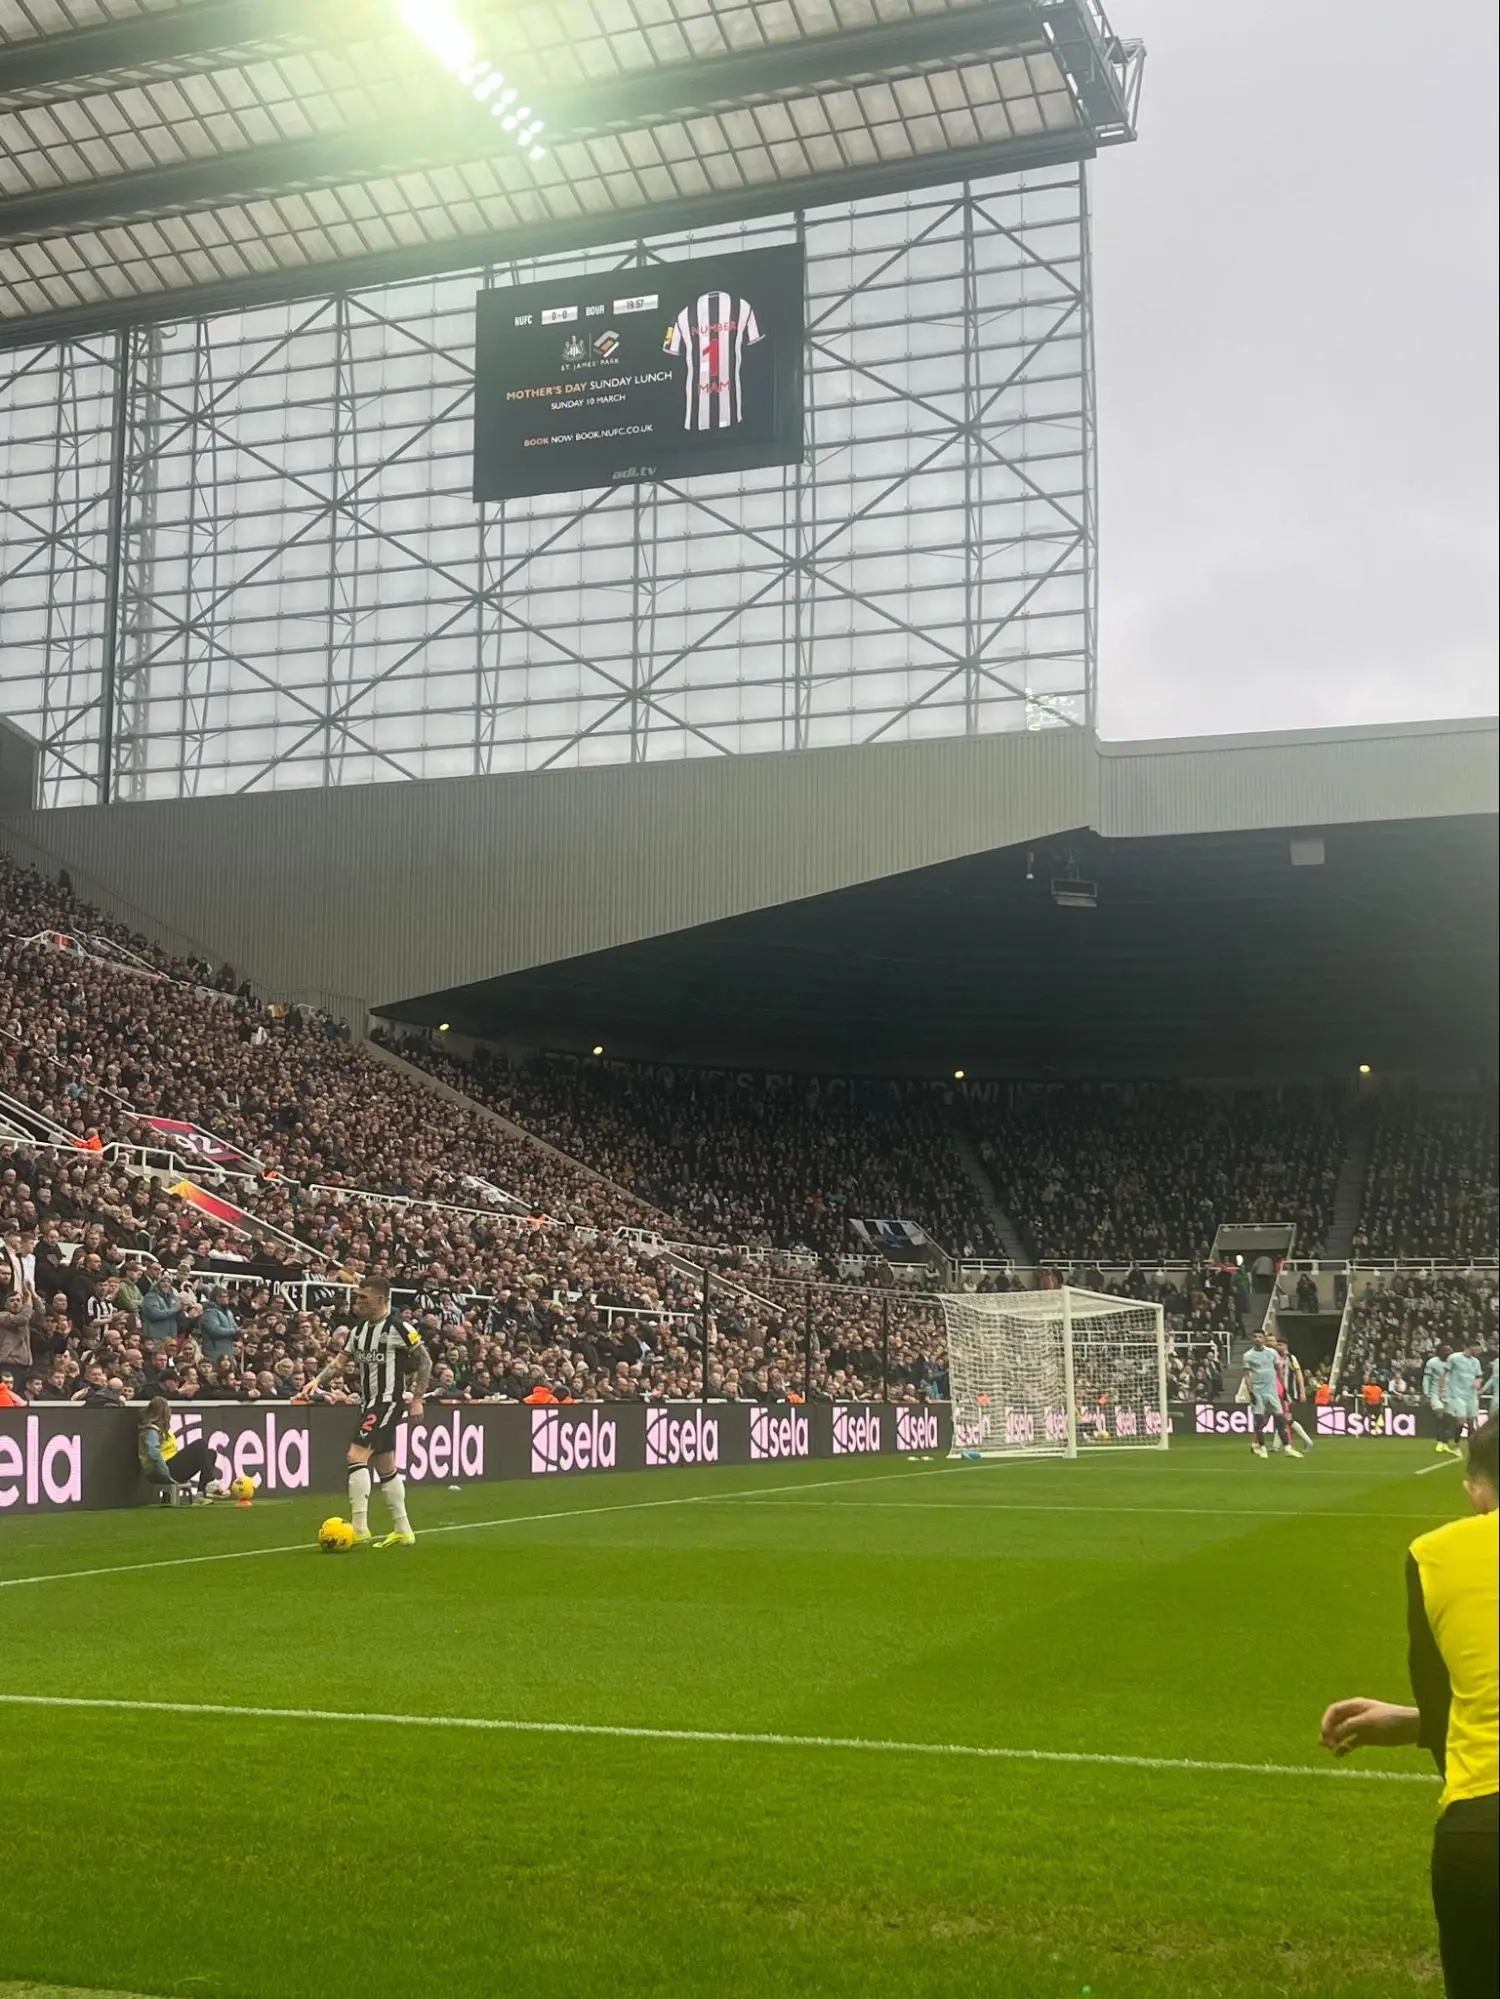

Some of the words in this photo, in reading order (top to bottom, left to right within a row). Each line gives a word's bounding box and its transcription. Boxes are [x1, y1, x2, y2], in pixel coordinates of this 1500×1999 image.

[514, 315, 533, 327] NUFC
[690, 320, 738, 336] NUMBER
[600, 357, 619, 366] PARK
[702, 338, 720, 377] 1
[506, 385, 562, 401] MOTHER'S
[565, 382, 588, 393] DAY
[589, 376, 633, 391] SUNDAY
[634, 370, 673, 386] LUNCH
[551, 398, 584, 410] SUNDAY
[586, 397, 595, 406] 10
[596, 393, 626, 405] MARCH
[524, 437, 549, 447] BOOK
[575, 424, 654, 441] BOOK.NUFC.CO.UK
[361, 1413, 377, 1431] 2
[560, 1409, 617, 1470] sela
[671, 1408, 718, 1464] sela
[768, 1407, 809, 1457] sela
[846, 1406, 880, 1453] sela
[908, 1406, 938, 1450] sela
[1347, 1407, 1416, 1437] sela
[207, 1412, 310, 1489] sela
[409, 1410, 484, 1481] sela
